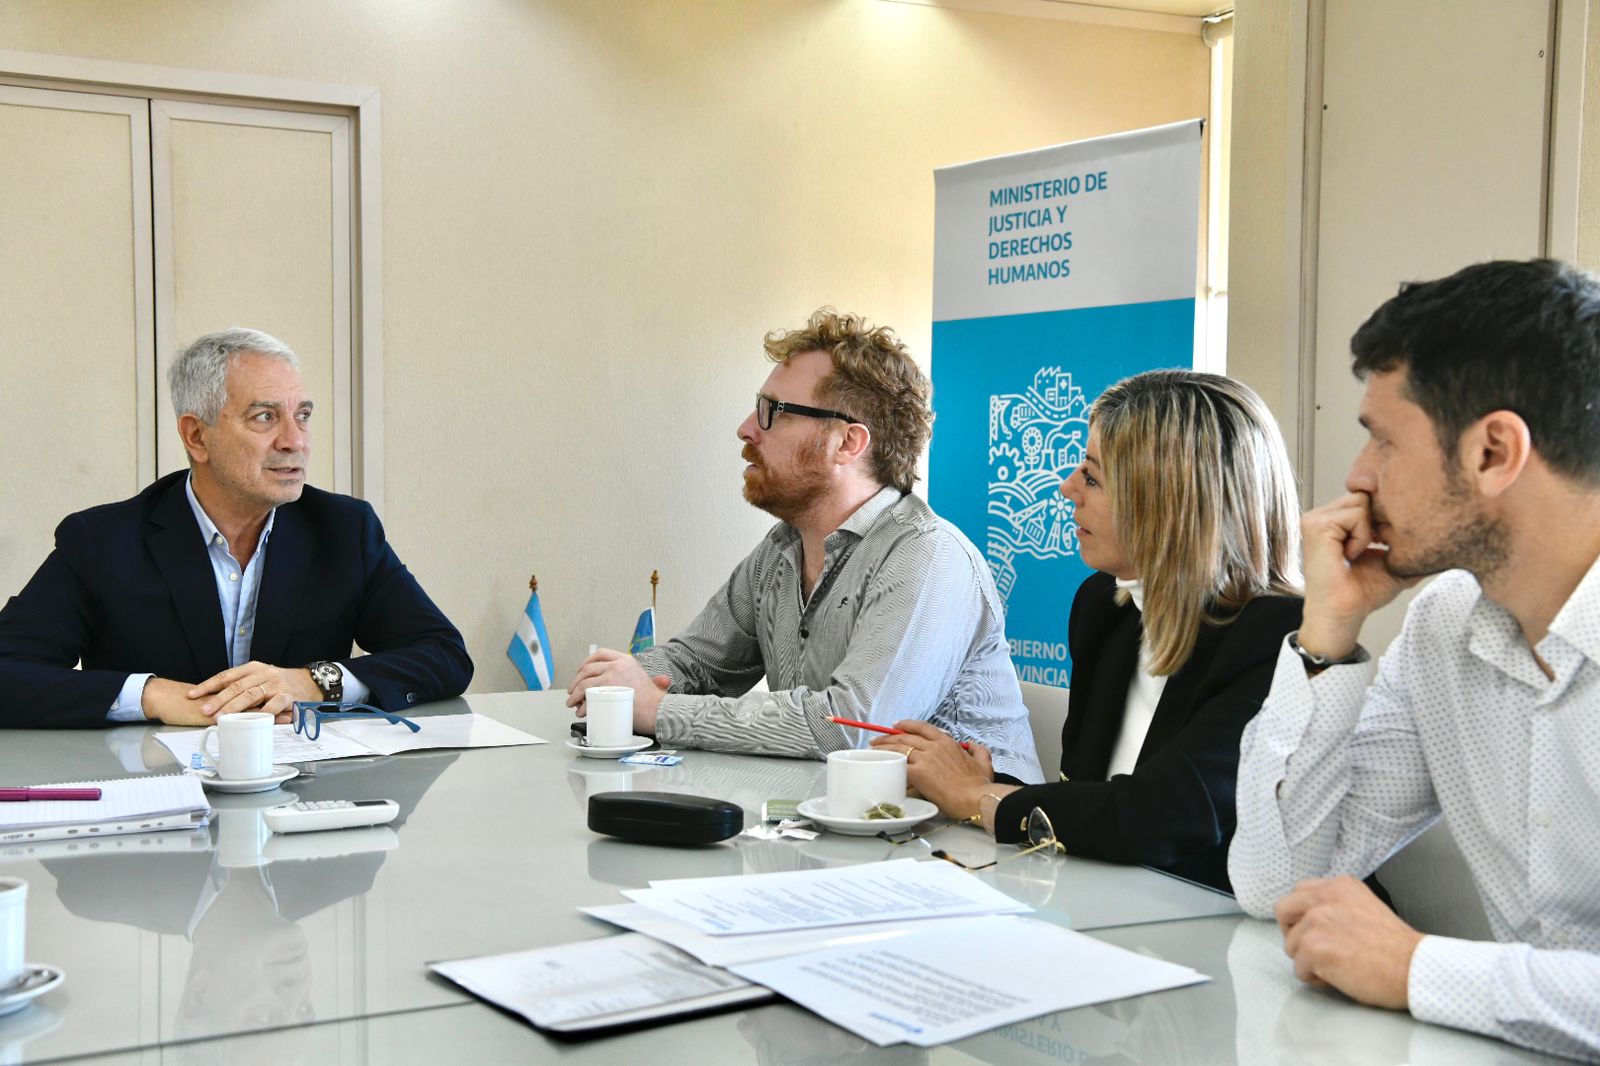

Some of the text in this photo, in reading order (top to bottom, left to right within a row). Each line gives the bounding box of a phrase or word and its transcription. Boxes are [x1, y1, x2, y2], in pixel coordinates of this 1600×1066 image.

[989, 171, 1108, 207] MINISTERIO DE
[988, 205, 1068, 236] JUSTICIA Y
[989, 232, 1072, 259] DERECHOS
[988, 259, 1071, 285] HUMANOS
[1009, 639, 1066, 661] BIERNO
[1016, 664, 1069, 687] VINCIA
